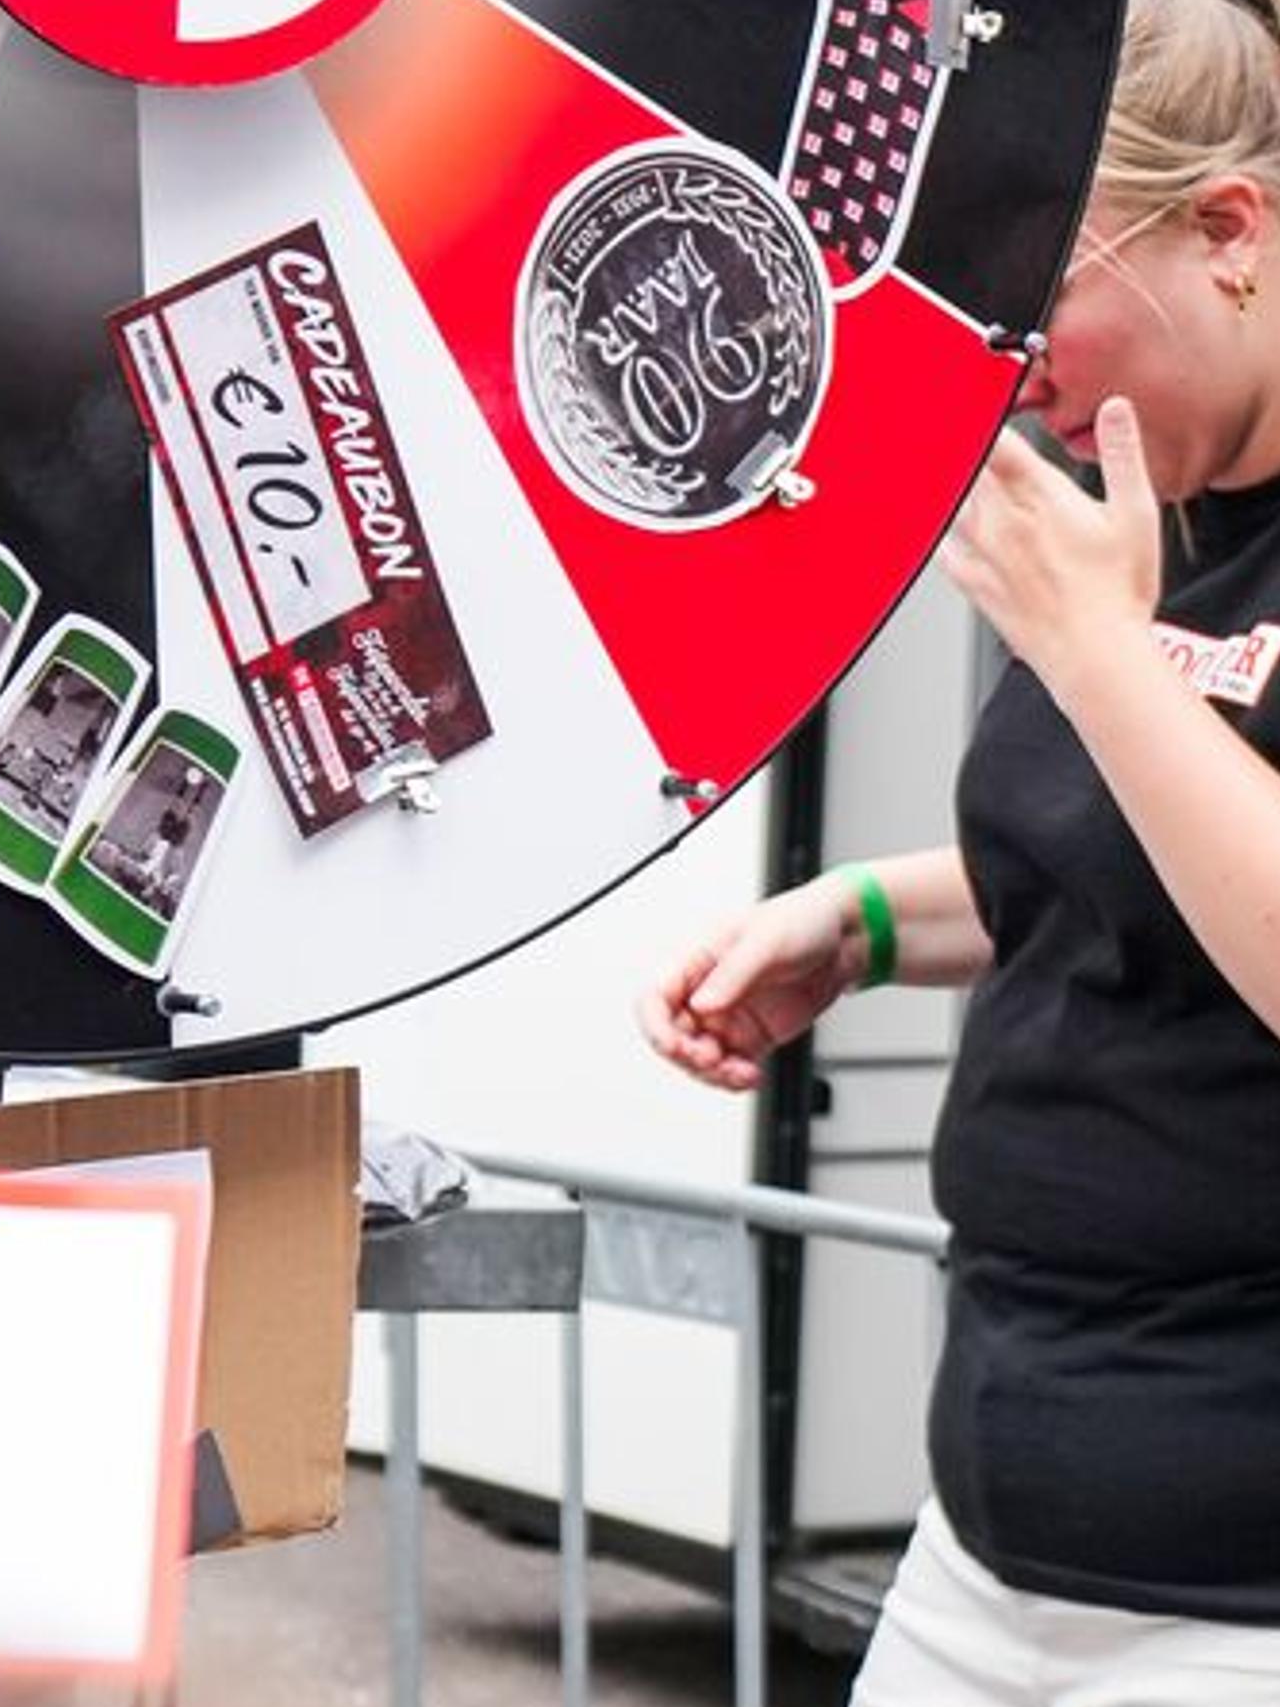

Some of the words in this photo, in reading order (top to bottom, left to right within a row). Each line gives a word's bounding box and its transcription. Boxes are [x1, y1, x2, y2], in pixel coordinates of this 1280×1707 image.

[583, 230, 716, 366] JAAR
[621, 282, 768, 456] 90
[266, 247, 423, 584] CADEAUBON
